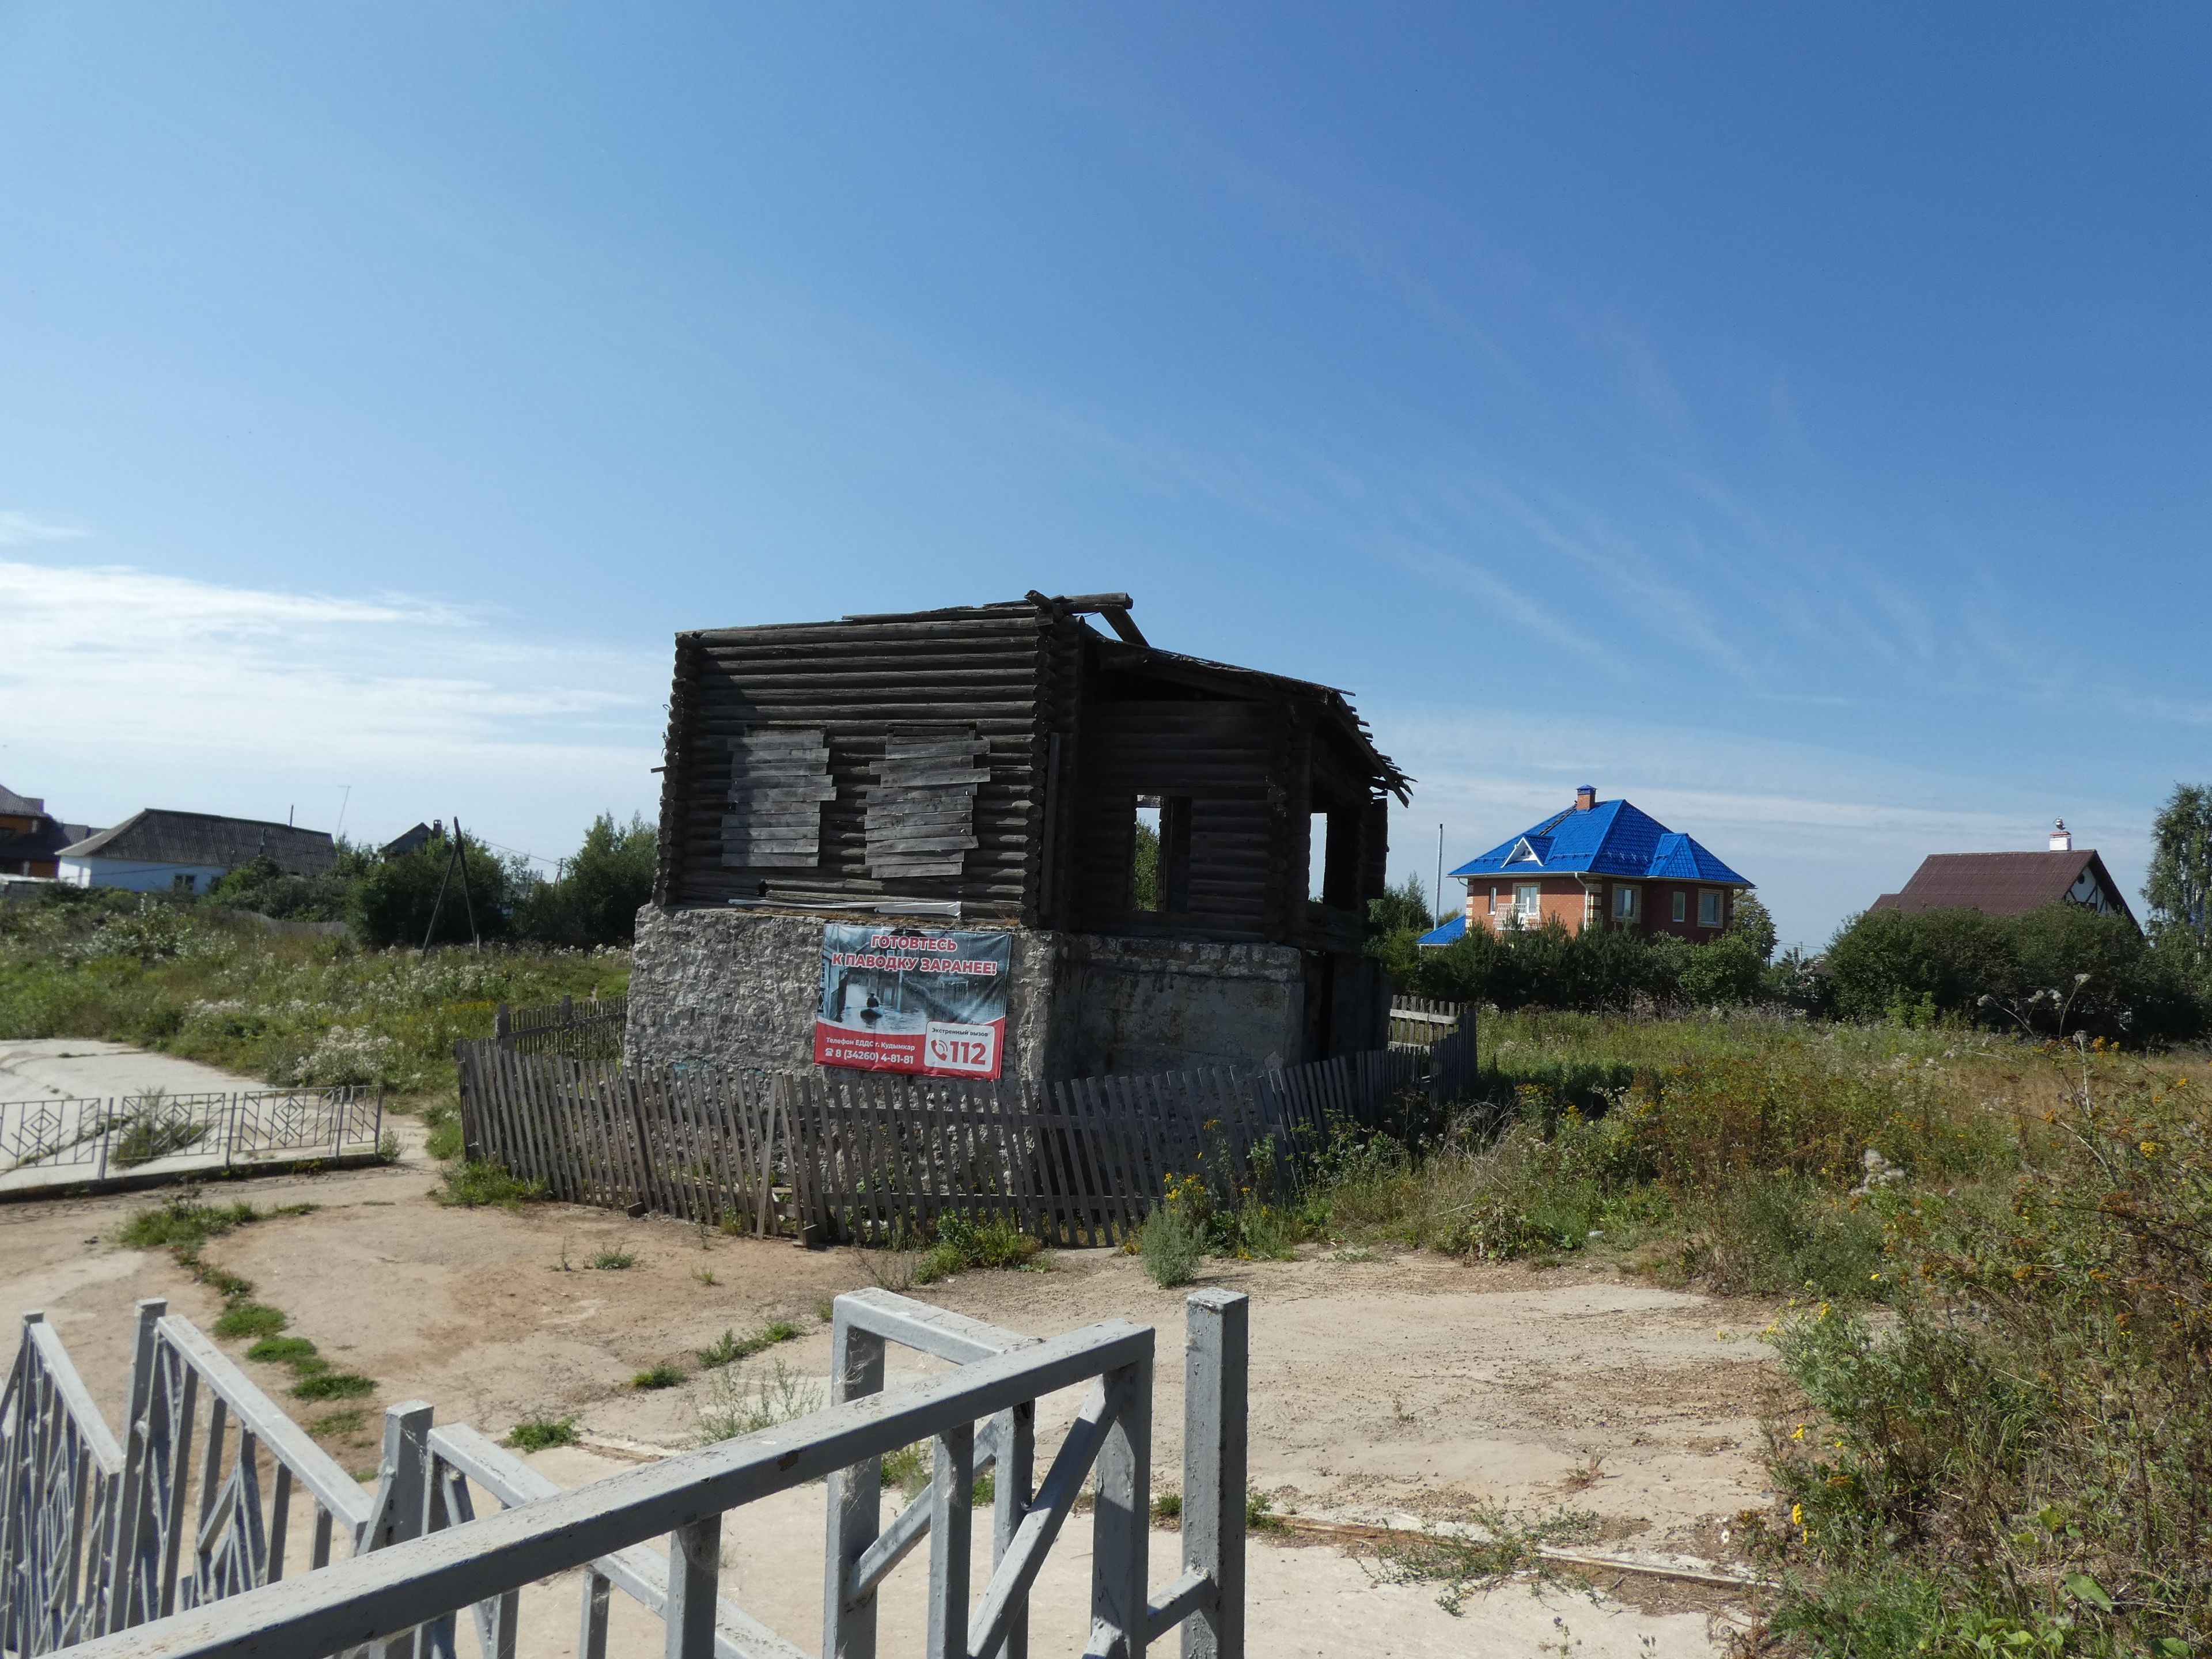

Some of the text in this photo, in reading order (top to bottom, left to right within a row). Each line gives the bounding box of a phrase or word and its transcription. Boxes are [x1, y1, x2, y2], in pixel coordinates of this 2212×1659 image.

[872, 935, 957, 951] ГОТОВТЕСЬ
[833, 953, 997, 975] К ПАВОДКУ ЗАРАНЕЕ!
[855, 1039, 874, 1047] ЕДДС
[881, 1042, 915, 1051] Кудымкар
[950, 1041, 986, 1065] 112
[835, 1049, 914, 1064] 8 (34260) 4-81-81
